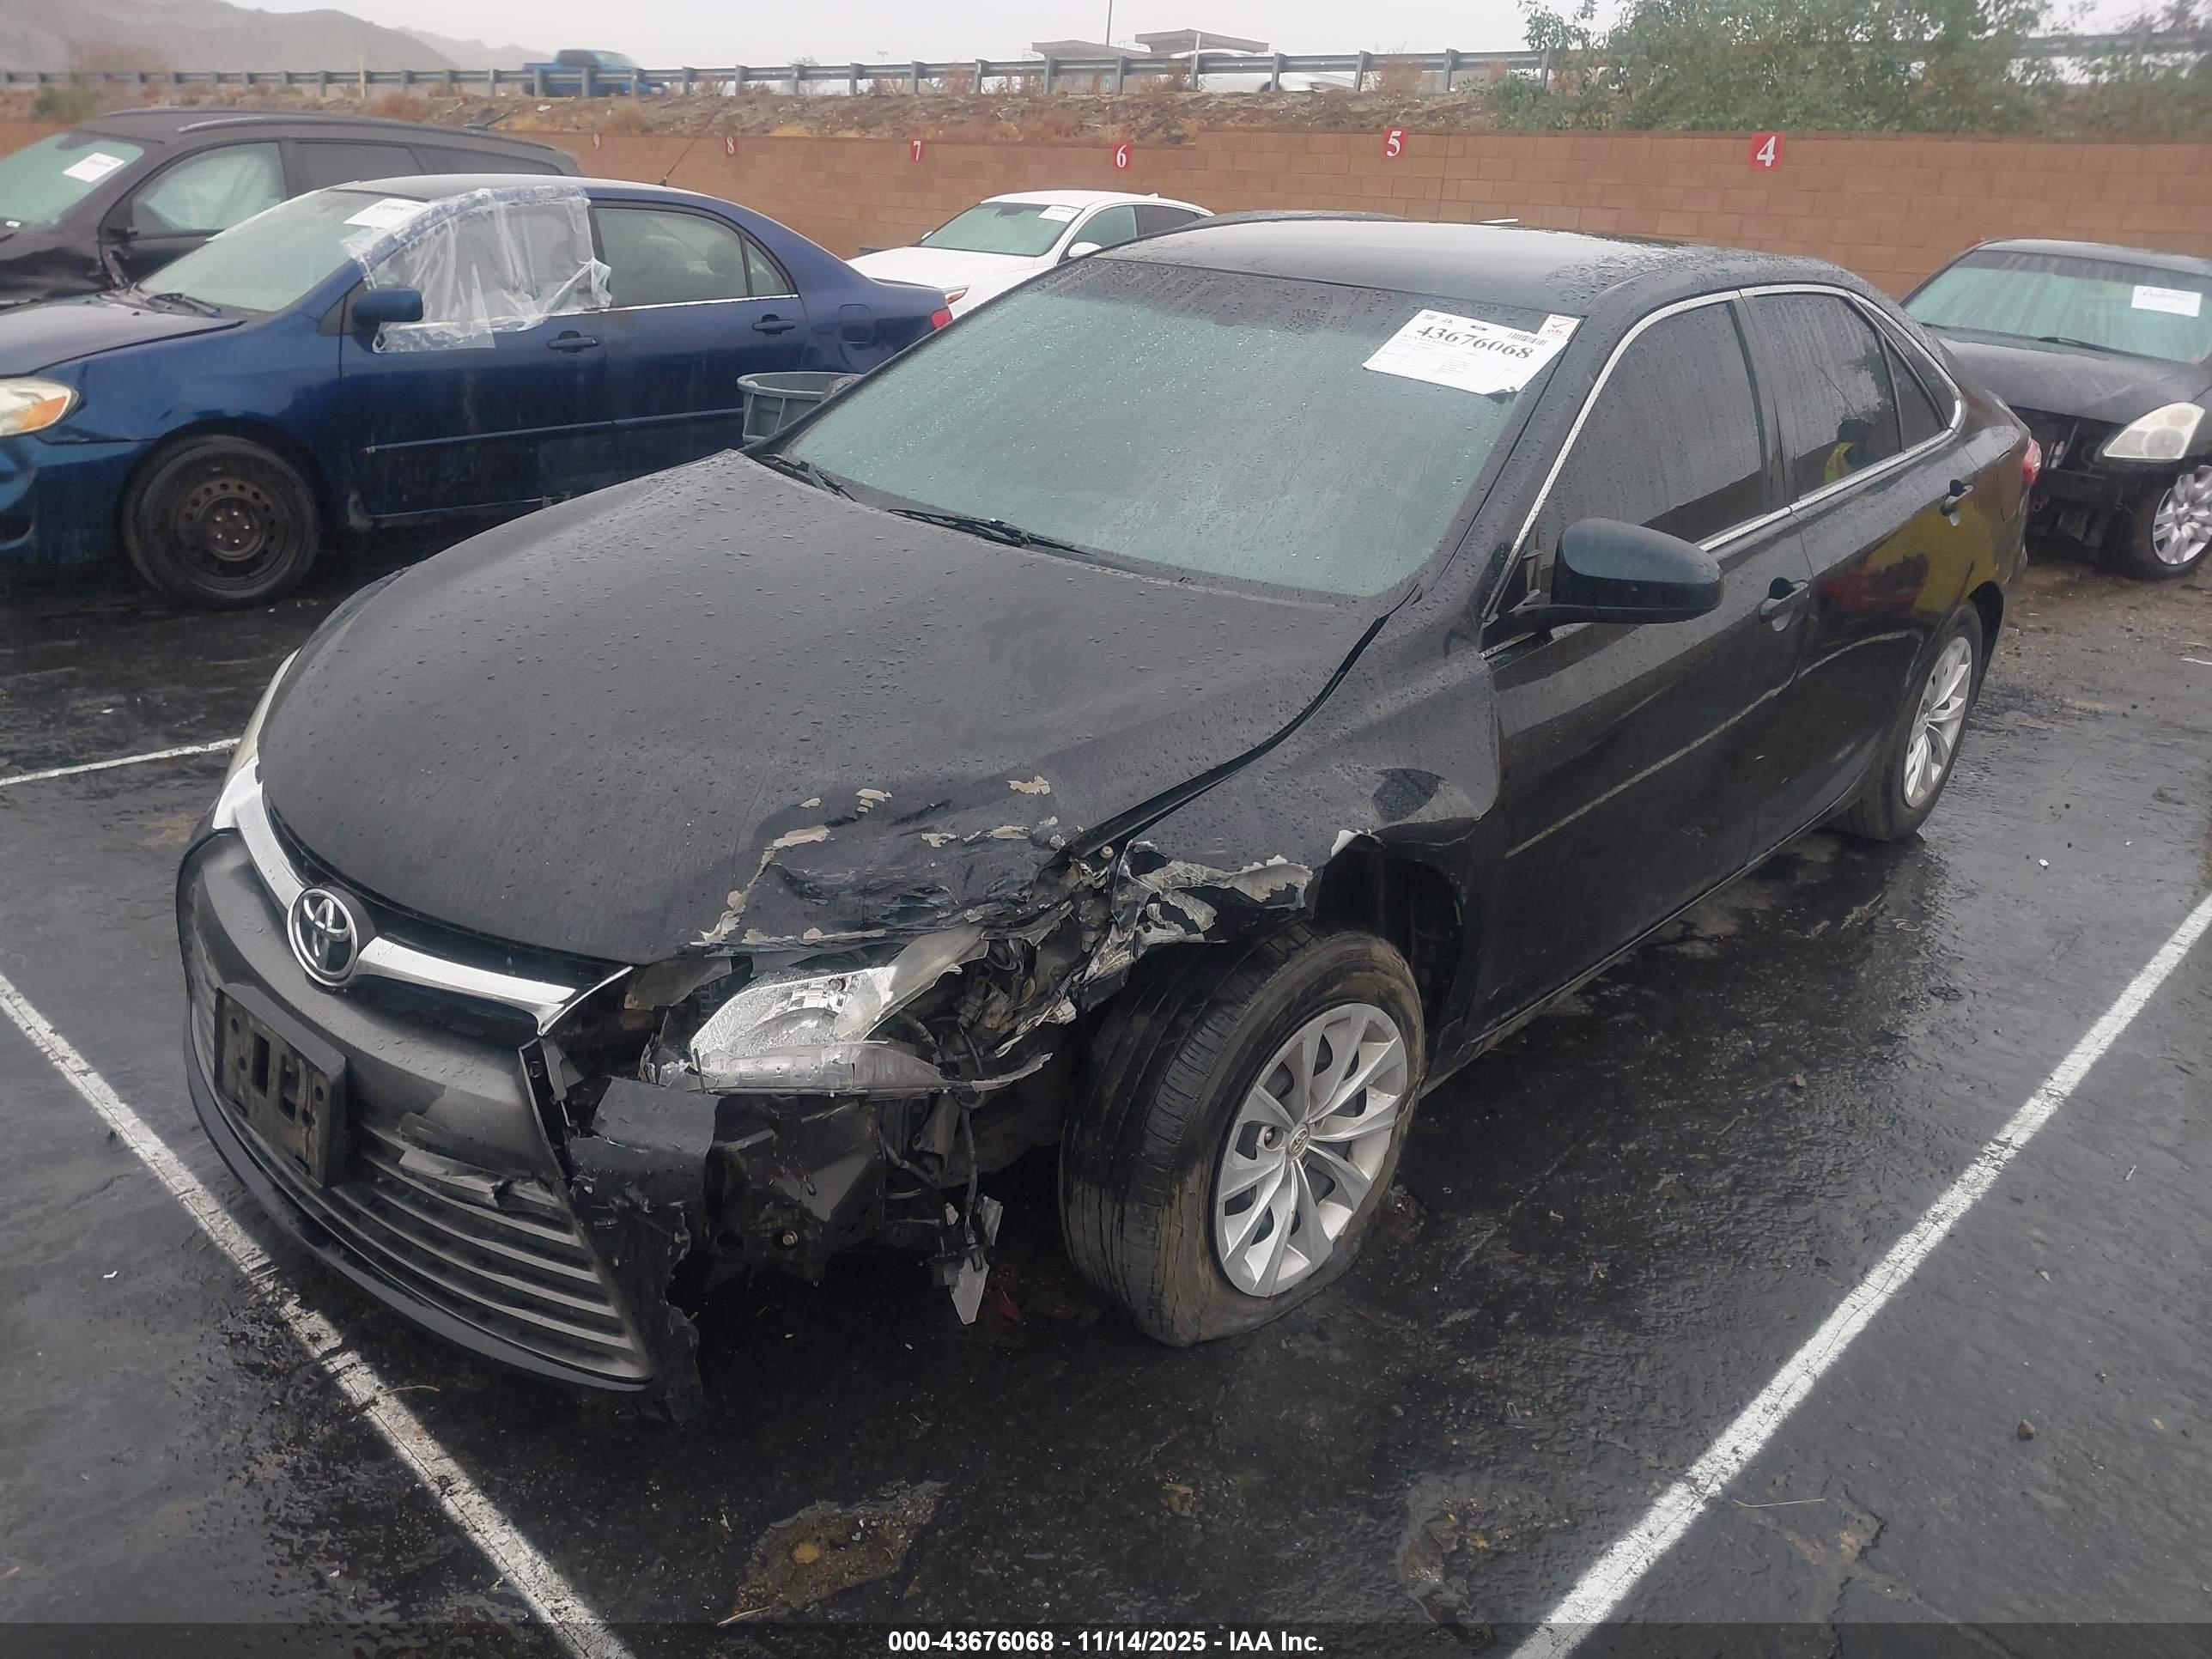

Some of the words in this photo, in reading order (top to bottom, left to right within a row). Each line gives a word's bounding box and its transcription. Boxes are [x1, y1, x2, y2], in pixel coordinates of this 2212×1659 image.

[726, 136, 734, 155] 8
[913, 140, 921, 161] 7
[1386, 131, 1401, 156] 5
[1757, 136, 1776, 167] 4
[1116, 144, 1127, 168] 6
[1416, 325, 1534, 359] 43676068
